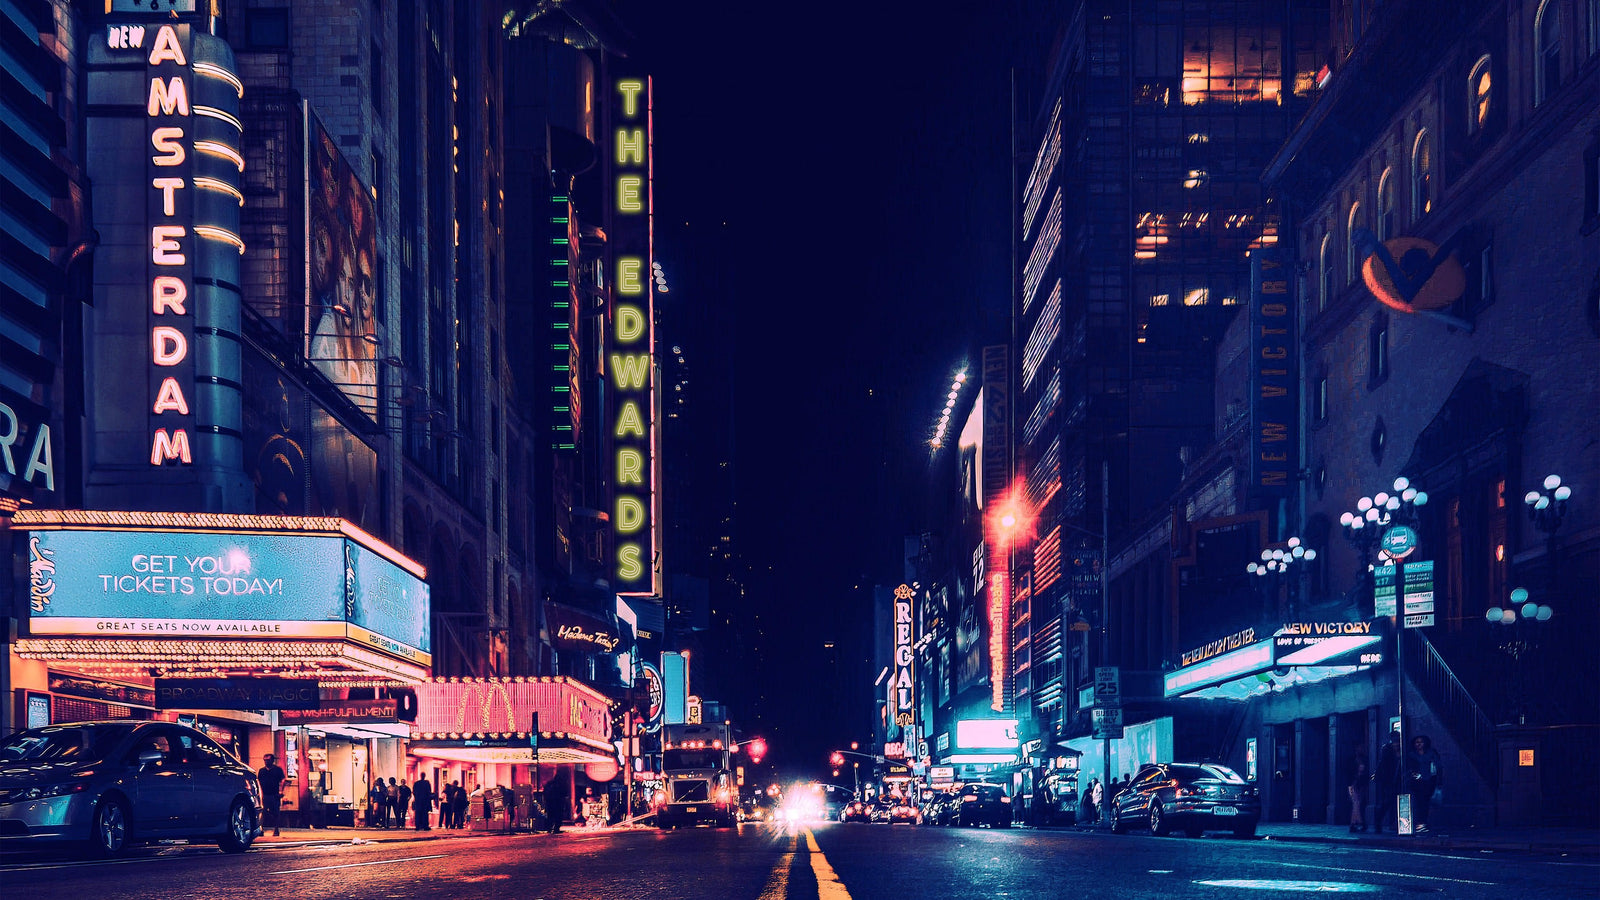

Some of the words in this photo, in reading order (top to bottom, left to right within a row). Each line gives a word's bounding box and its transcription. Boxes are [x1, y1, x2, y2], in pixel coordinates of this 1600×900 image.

[107, 25, 145, 49] NEW
[618, 81, 642, 210] THE
[147, 24, 193, 466] AMSTERDAM
[1261, 258, 1288, 399] VICTORY
[613, 259, 649, 579] EDWARDS
[1261, 421, 1288, 487] NEW
[30, 536, 56, 612] Aladdin
[131, 554, 177, 573] GET
[184, 554, 251, 575] YOUR
[98, 573, 195, 595] TICKETS
[200, 575, 283, 596] TODAY!
[96, 621, 136, 631] GREAT
[141, 622, 178, 632] SEATS
[182, 623, 212, 632] NOW
[216, 623, 281, 633] AVAILABLE
[557, 624, 594, 642] Madame
[1283, 622, 1312, 635] NEW
[1314, 621, 1372, 635] VICTORY
[896, 601, 915, 710] REGAL
[160, 686, 252, 702] BROADWAY
[1097, 682, 1118, 695] 25
[1096, 709, 1119, 717] BUSES
[1098, 717, 1117, 725] ONLY
